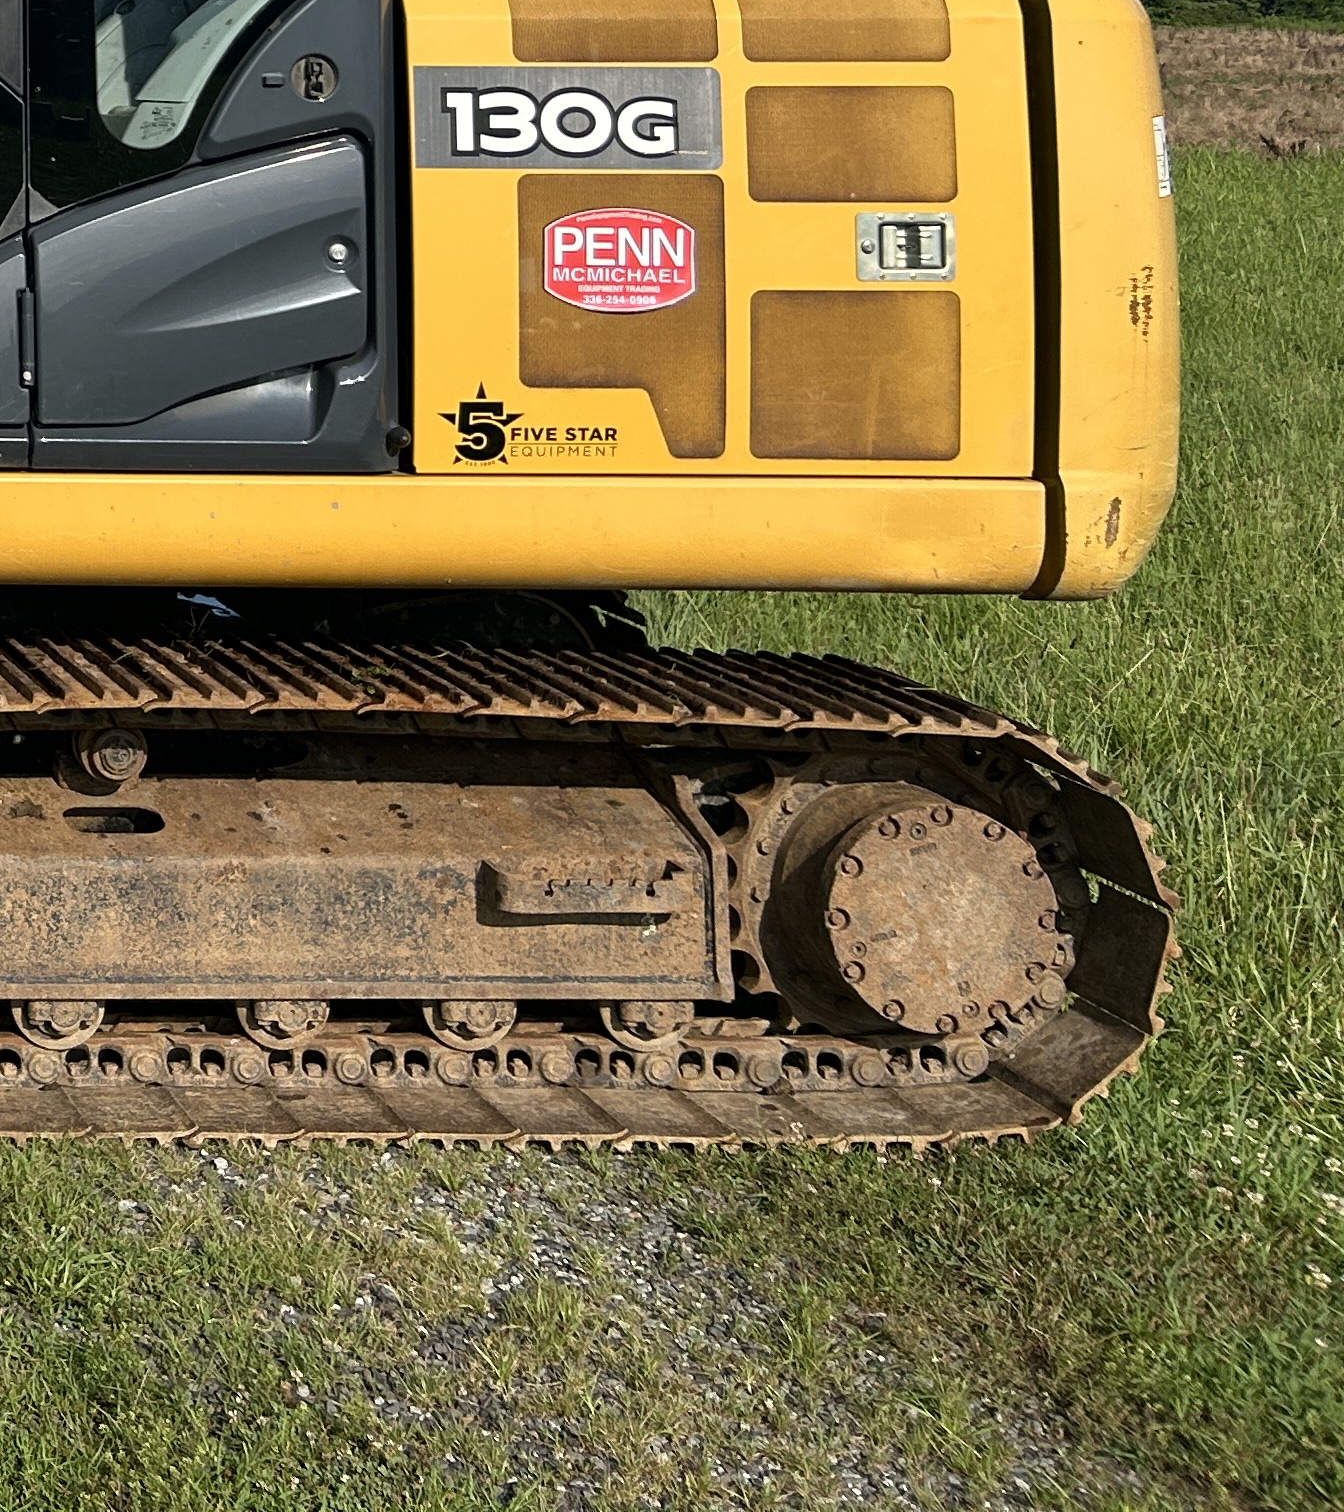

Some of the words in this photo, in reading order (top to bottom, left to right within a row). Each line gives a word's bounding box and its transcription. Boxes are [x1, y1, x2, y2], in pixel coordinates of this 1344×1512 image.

[442, 88, 678, 157] 130G
[554, 226, 685, 267] PENN
[552, 267, 686, 283] MCMICHAEL
[455, 401, 506, 461] 5
[510, 427, 558, 442] FIVE
[565, 427, 618, 442] STAR
[510, 445, 618, 458] EQUIPMENT
